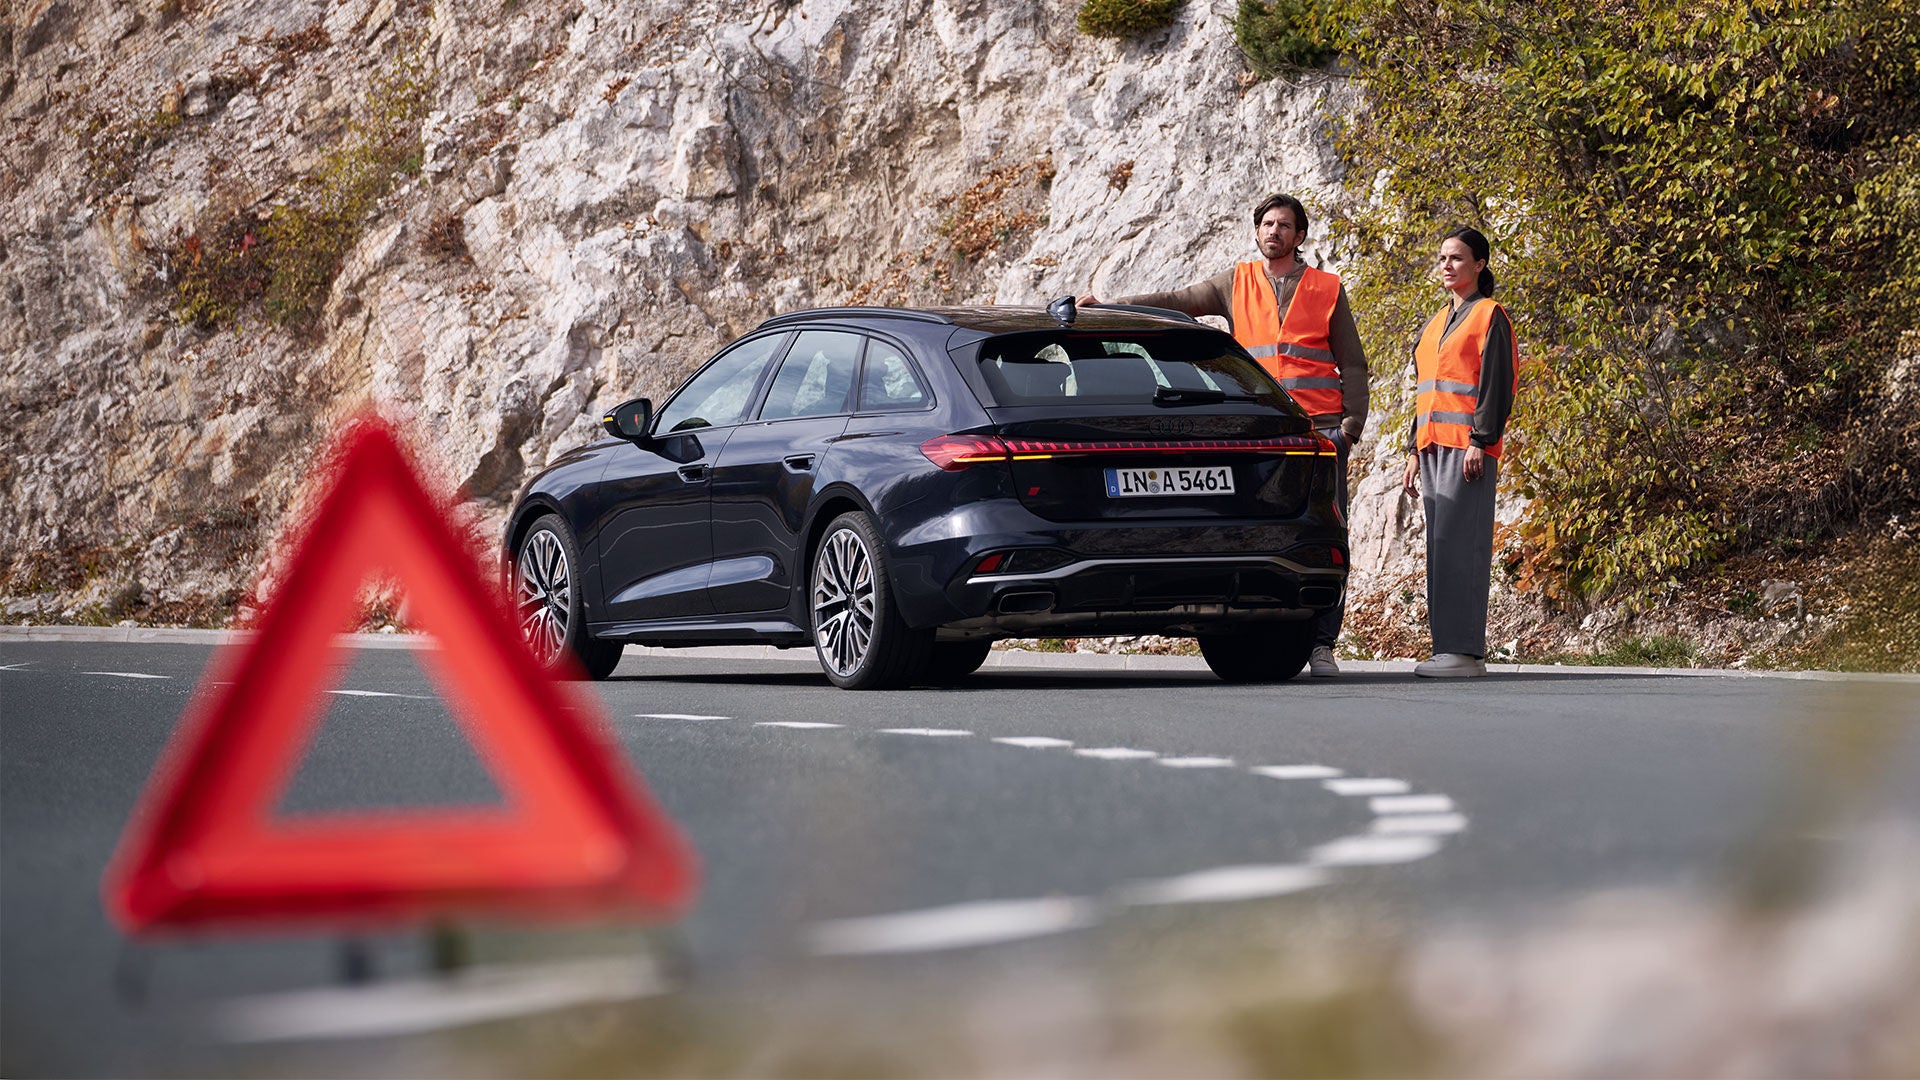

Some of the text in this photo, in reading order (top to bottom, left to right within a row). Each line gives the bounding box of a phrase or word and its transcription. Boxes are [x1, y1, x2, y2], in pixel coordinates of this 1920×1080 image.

[1122, 469, 1232, 493] IN A 5461
